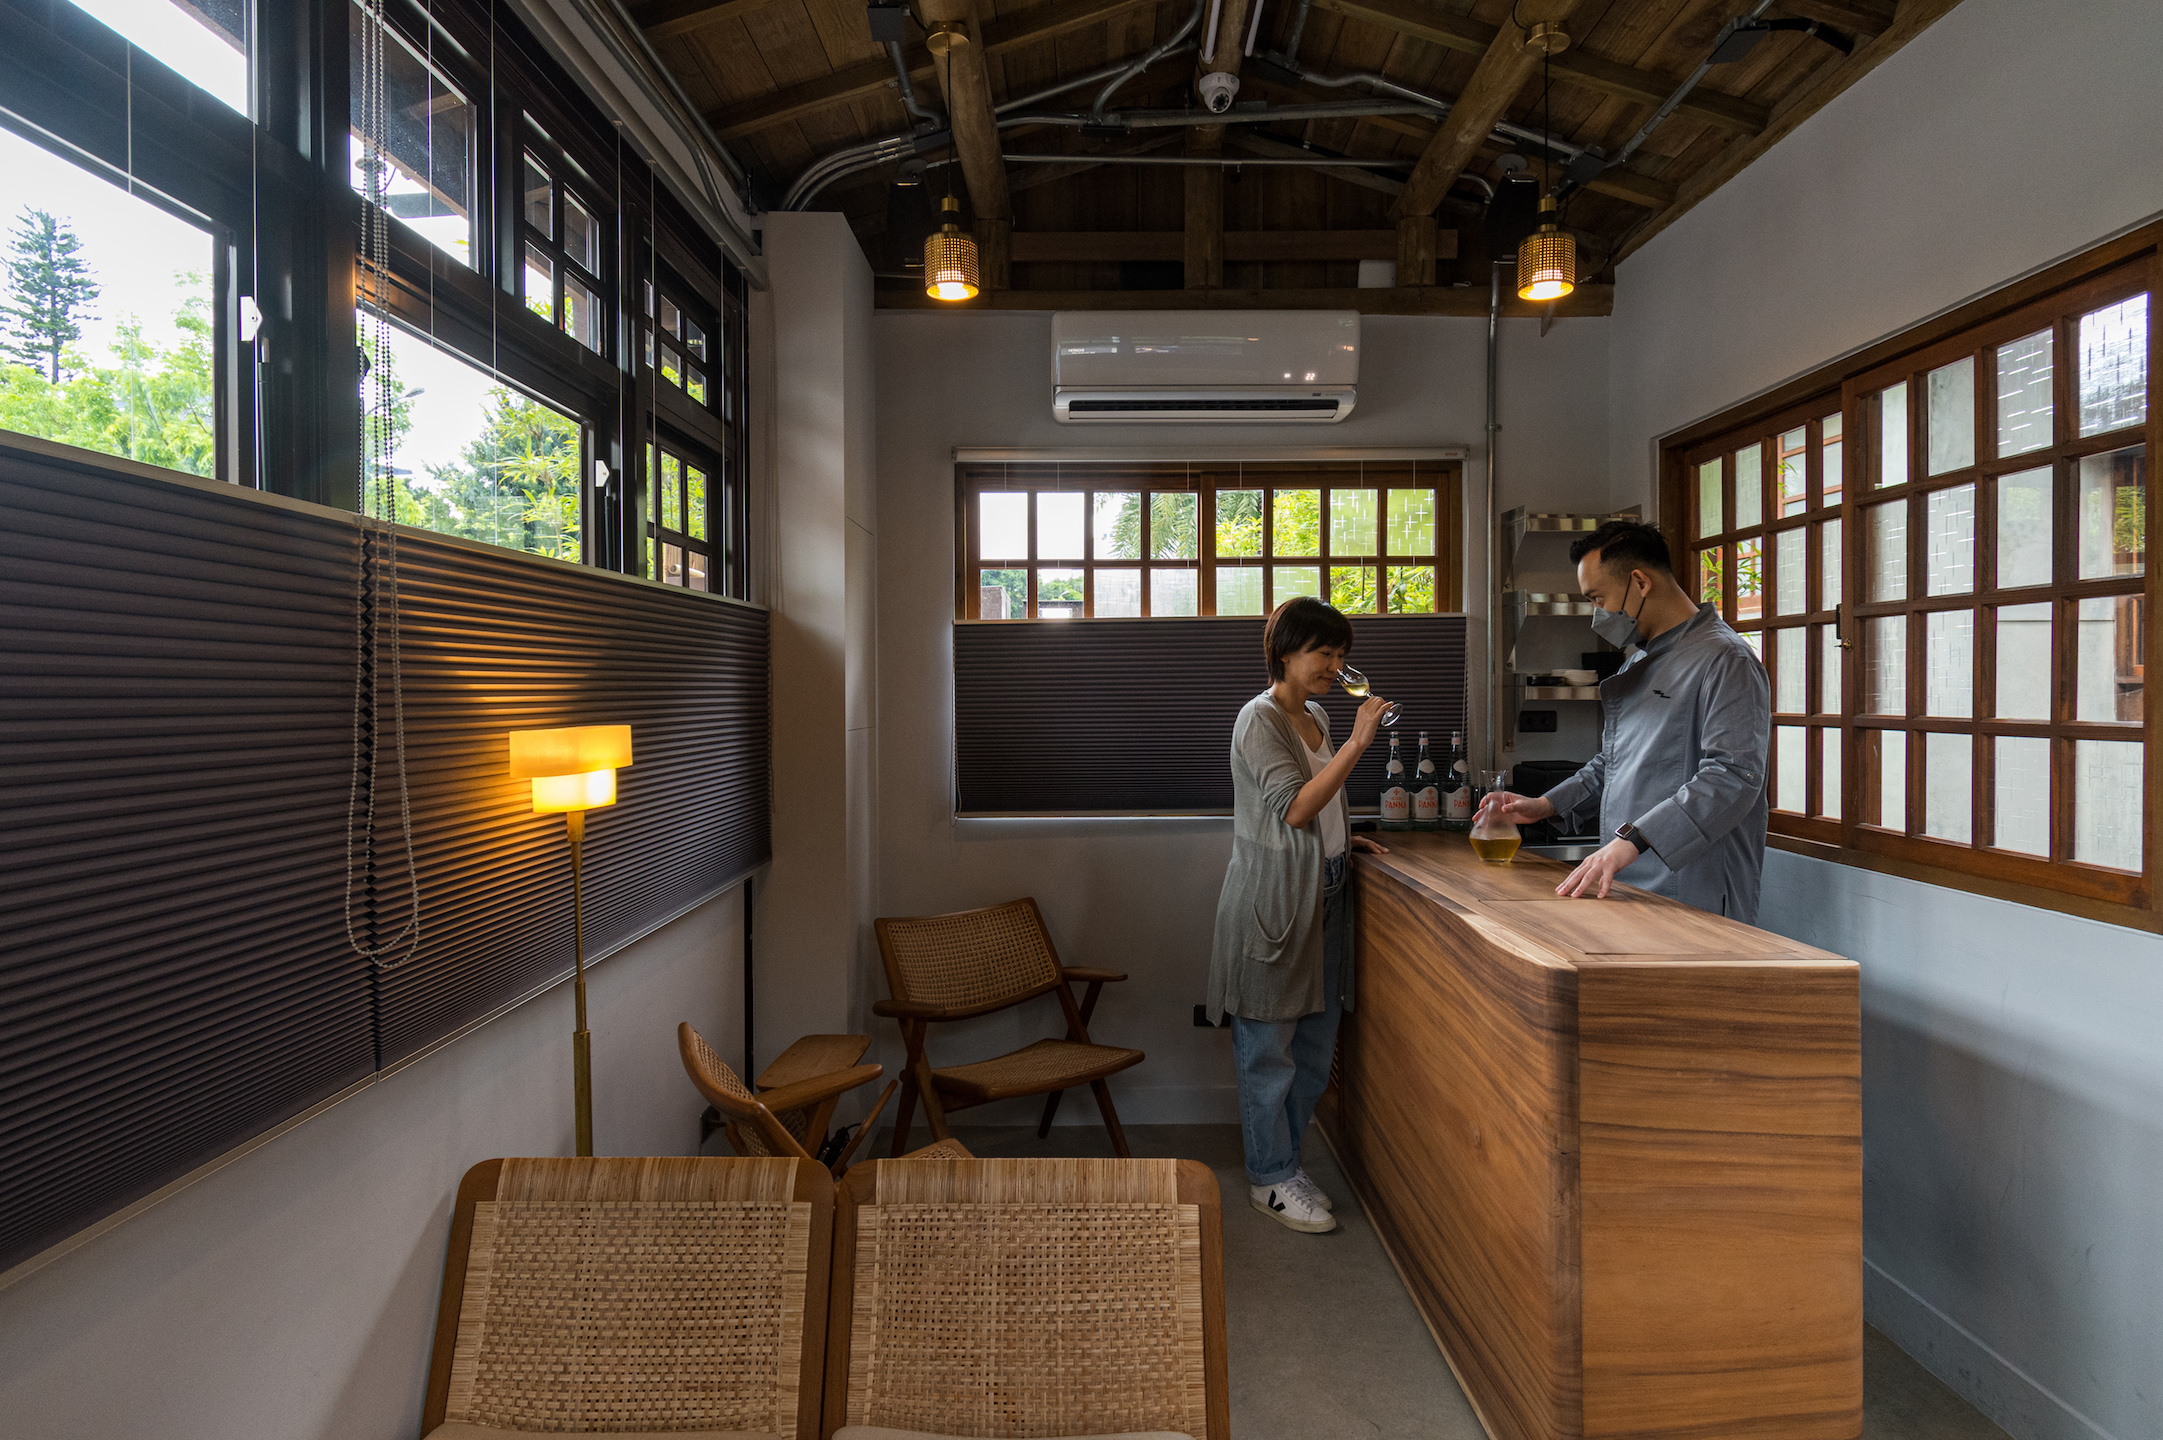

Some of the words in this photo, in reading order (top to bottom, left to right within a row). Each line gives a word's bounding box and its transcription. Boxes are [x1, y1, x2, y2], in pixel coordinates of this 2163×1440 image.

[1305, 373, 1316, 381] 22
[1385, 800, 1407, 809] PANNA
[1418, 800, 1438, 809] PANN
